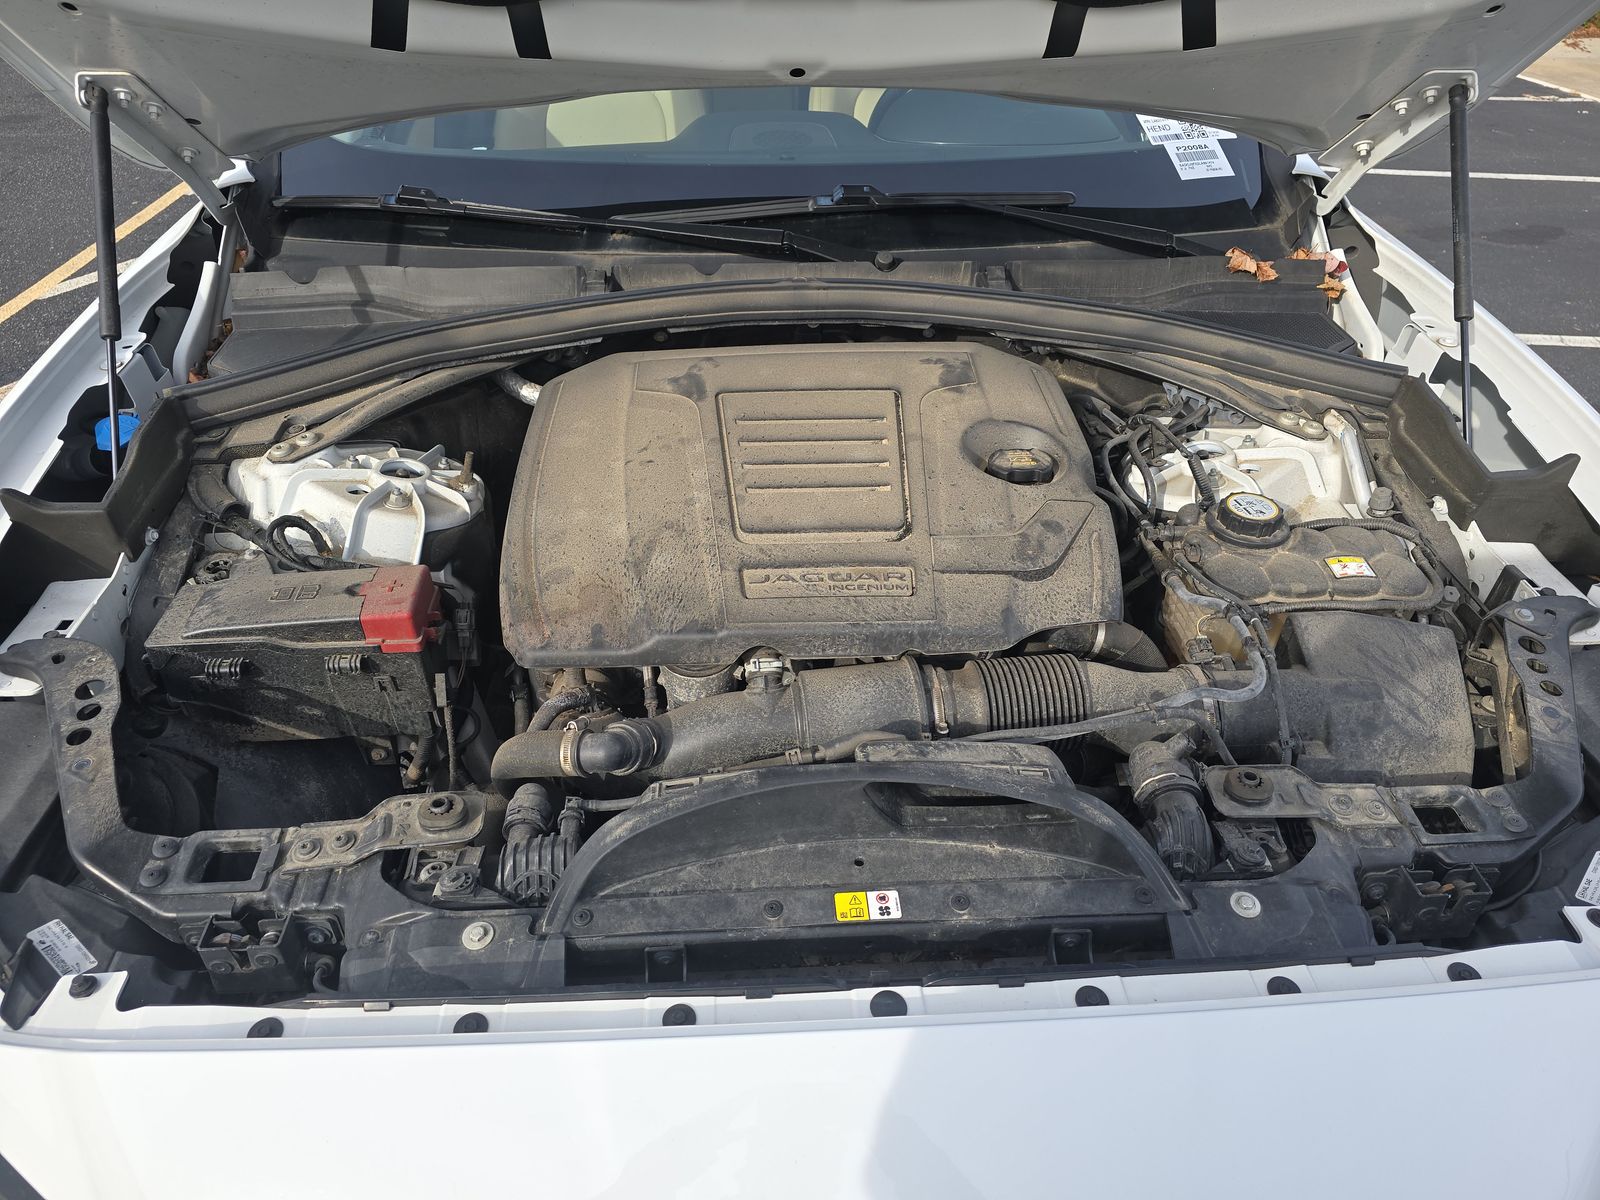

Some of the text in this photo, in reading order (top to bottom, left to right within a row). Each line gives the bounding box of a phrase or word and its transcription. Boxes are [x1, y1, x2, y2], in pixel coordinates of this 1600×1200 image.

[1176, 144, 1210, 152] P2008A
[749, 572, 907, 585] JAGUAR
[828, 583, 909, 591] INGENIUM
